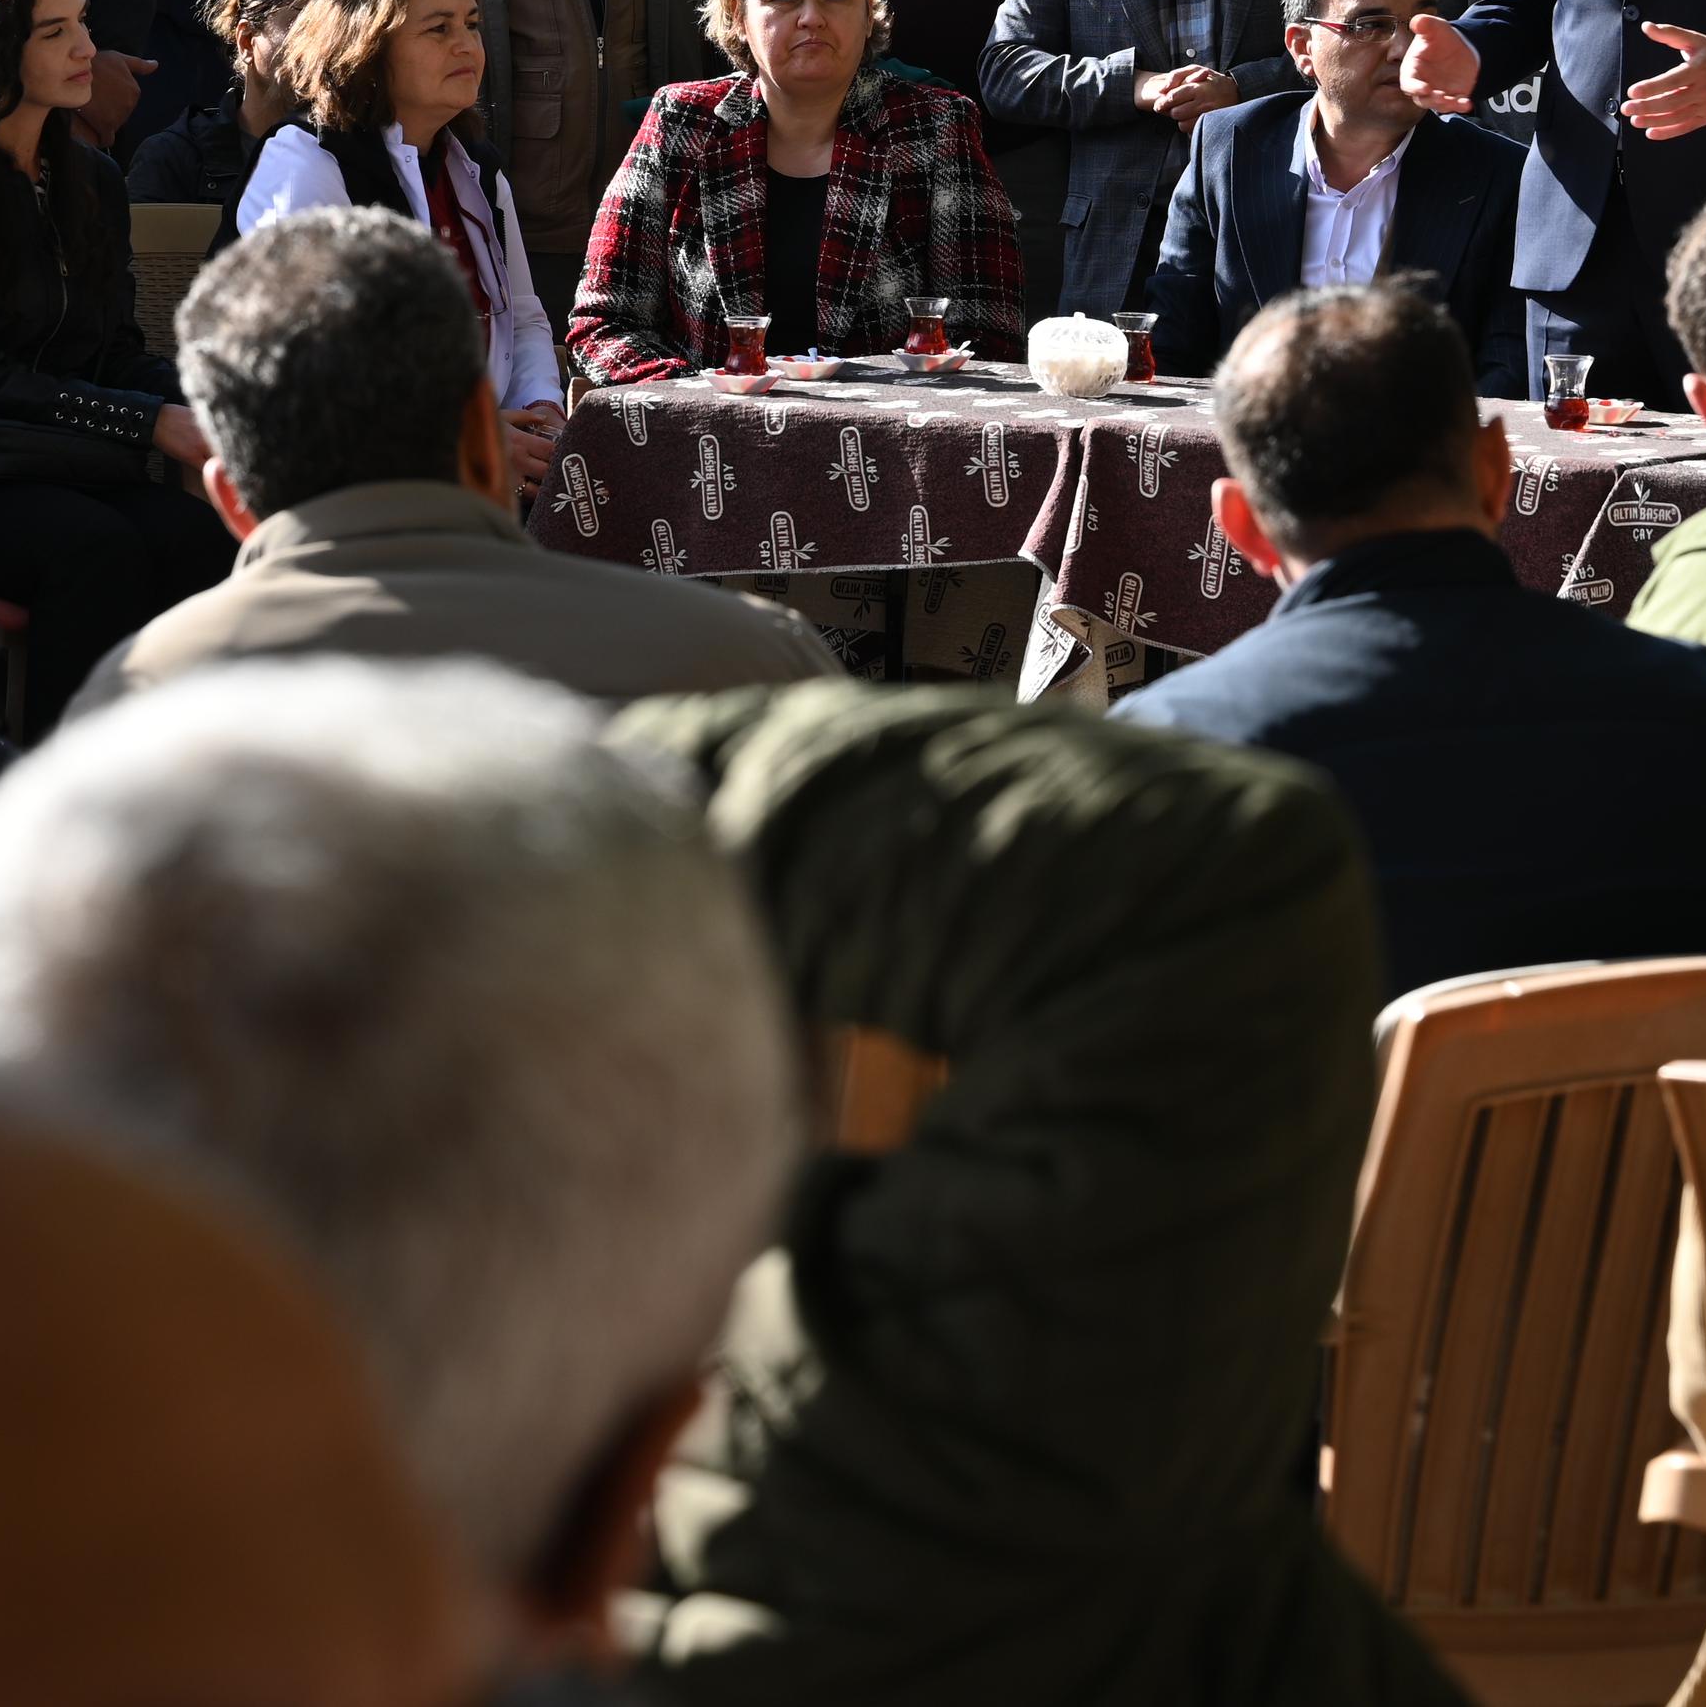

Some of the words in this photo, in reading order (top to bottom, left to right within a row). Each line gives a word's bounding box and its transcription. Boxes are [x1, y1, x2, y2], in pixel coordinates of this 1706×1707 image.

[705, 444, 717, 481] BAŞAK
[845, 437, 862, 474] BAŞAK
[987, 429, 1001, 468] BAŞAK
[1007, 450, 1021, 479] ÇAY
[1125, 434, 1139, 464] ÇAY
[569, 462, 587, 501] BAŞAK
[723, 463, 738, 491] ÇAY
[865, 456, 880, 483] ÇAY
[990, 469, 1003, 502] ALTIN
[1141, 450, 1157, 490] BAŞAK
[1545, 461, 1562, 493] ÇAY
[592, 478, 608, 505] ÇAY
[707, 482, 719, 514] ALTIN
[850, 474, 866, 506] ALTIN
[1521, 476, 1538, 509] ALTIN
[578, 499, 595, 531] ALTIN
[913, 510, 924, 543] ALTIN
[1613, 507, 1639, 521] ALTIN
[1640, 507, 1673, 523] BAŞAK
[655, 524, 671, 554] ALTIN
[775, 516, 791, 548] ALTIN
[1209, 521, 1225, 560] BAŞAK
[1632, 527, 1653, 541] ÇAY
[759, 539, 771, 568] ÇAY
[1205, 559, 1219, 594] ALTIN
[1590, 583, 1610, 598] ALTIN
[1103, 591, 1116, 620] ÇAY
[1122, 577, 1138, 611] ALTIN
